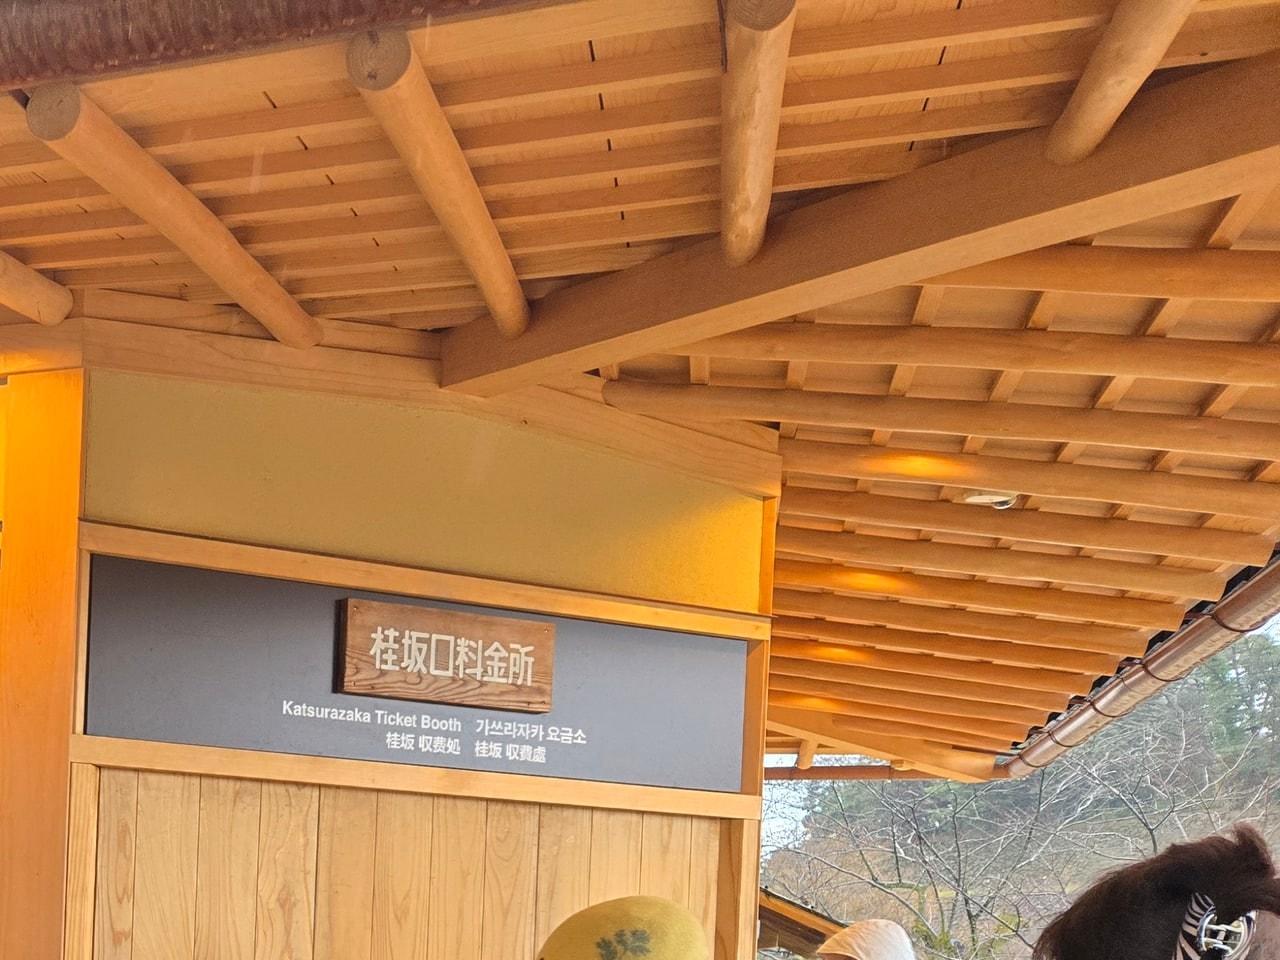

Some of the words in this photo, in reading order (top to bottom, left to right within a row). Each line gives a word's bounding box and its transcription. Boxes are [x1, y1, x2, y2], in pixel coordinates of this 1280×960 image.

[370, 626, 535, 686] 桂坂口料金所
[282, 700, 371, 723] Katsurazaka
[375, 710, 417, 727] Ticket
[421, 714, 462, 732] Booth
[385, 731, 415, 751] 桂坂
[475, 718, 544, 741] 가쓰라자카
[546, 726, 587, 744] 요금소
[474, 740, 503, 759] 桂坂
